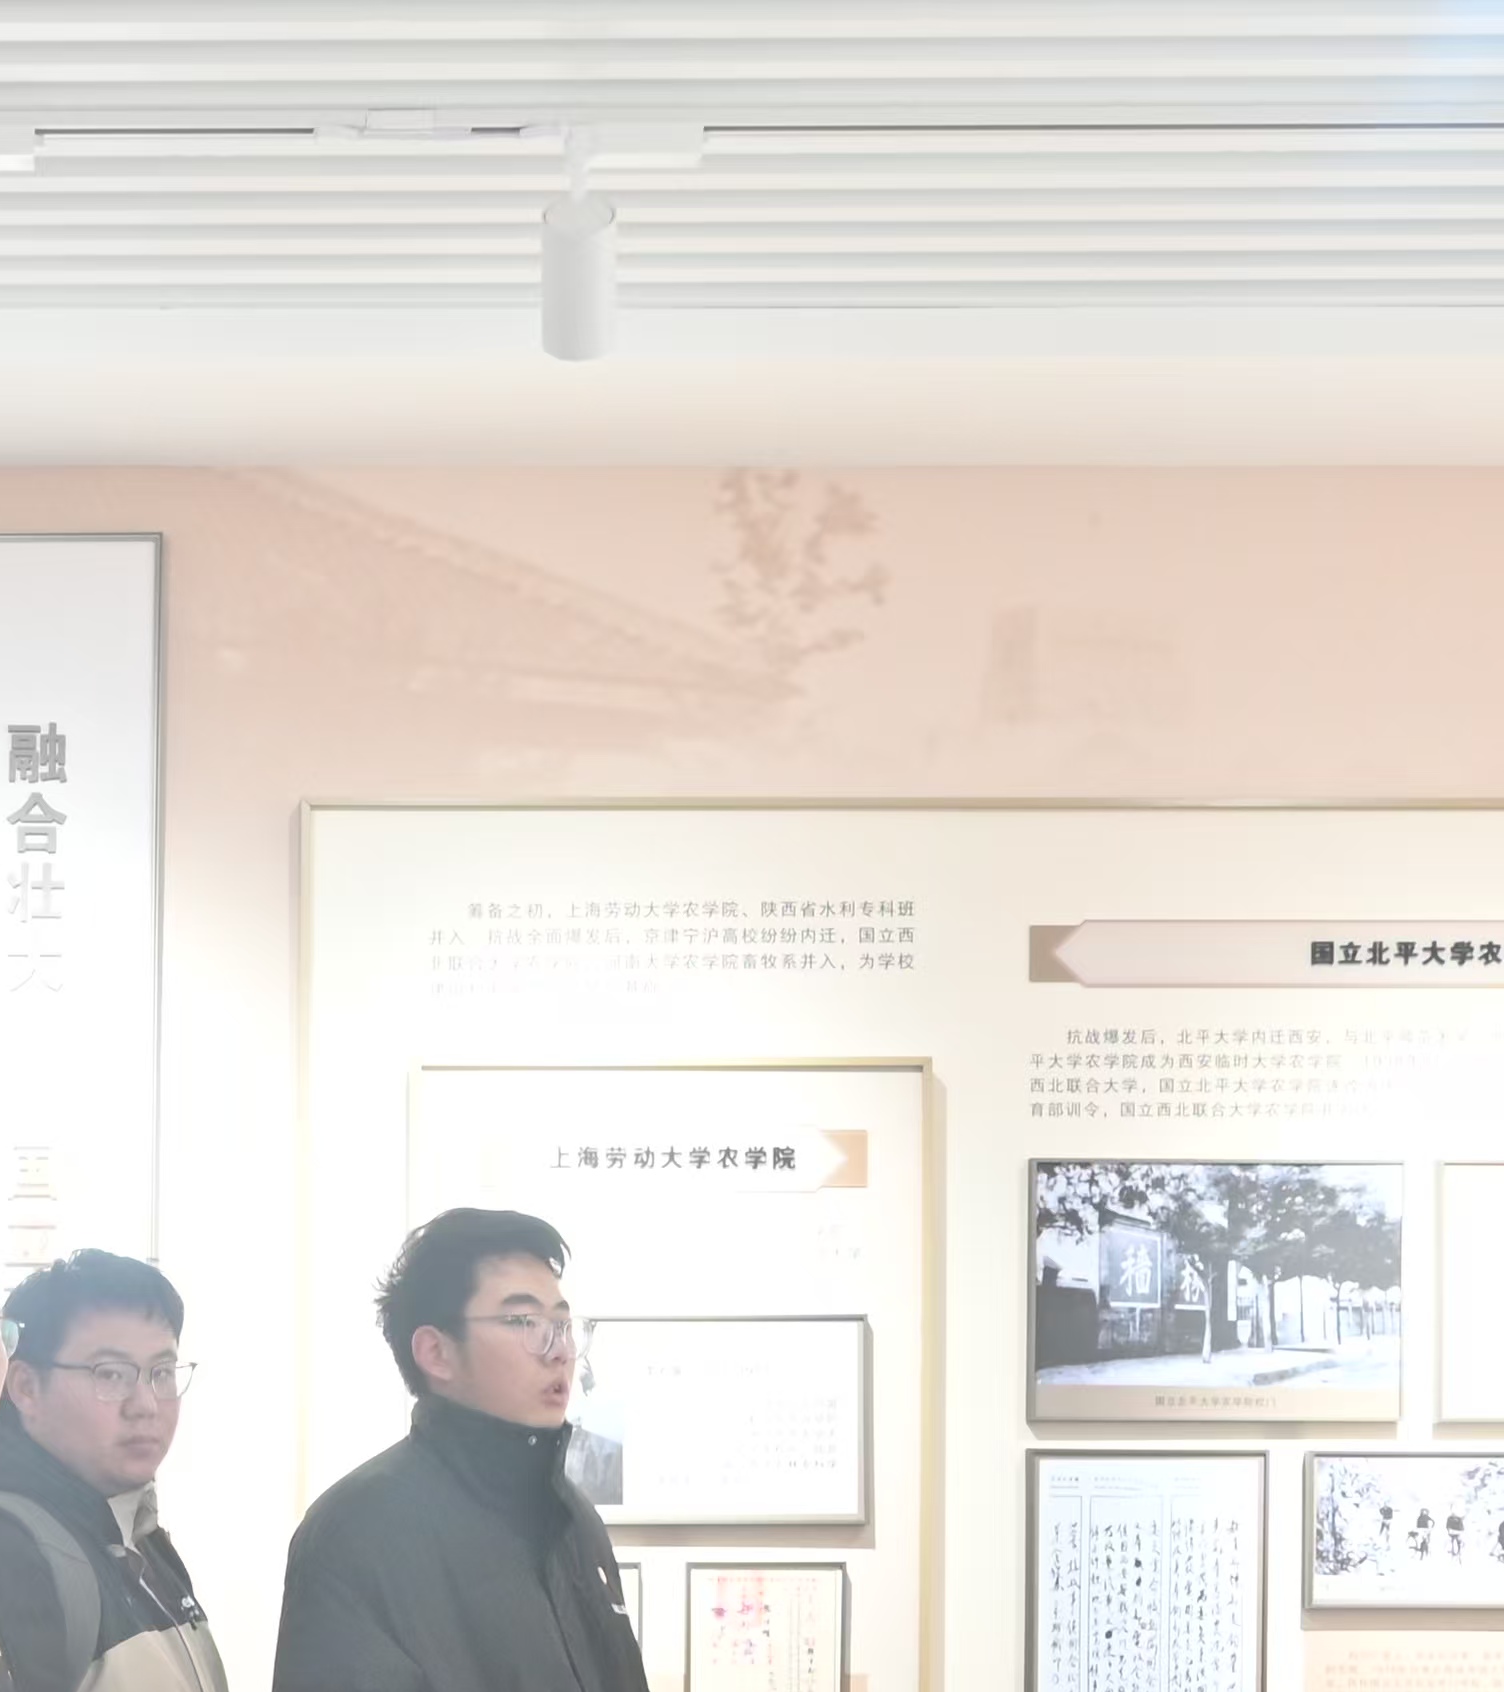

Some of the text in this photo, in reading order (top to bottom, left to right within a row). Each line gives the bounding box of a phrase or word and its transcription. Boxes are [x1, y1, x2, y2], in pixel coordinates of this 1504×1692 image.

[467, 900, 915, 919] 筹备之初，上海劳动大学农学院、陕西省水利专科班
[428, 926, 915, 945] 并入抗战全面爆发后，京津宁沪高校纷纷内迁，国立西
[551, 1145, 796, 1171] 上海劳动大学农学院
